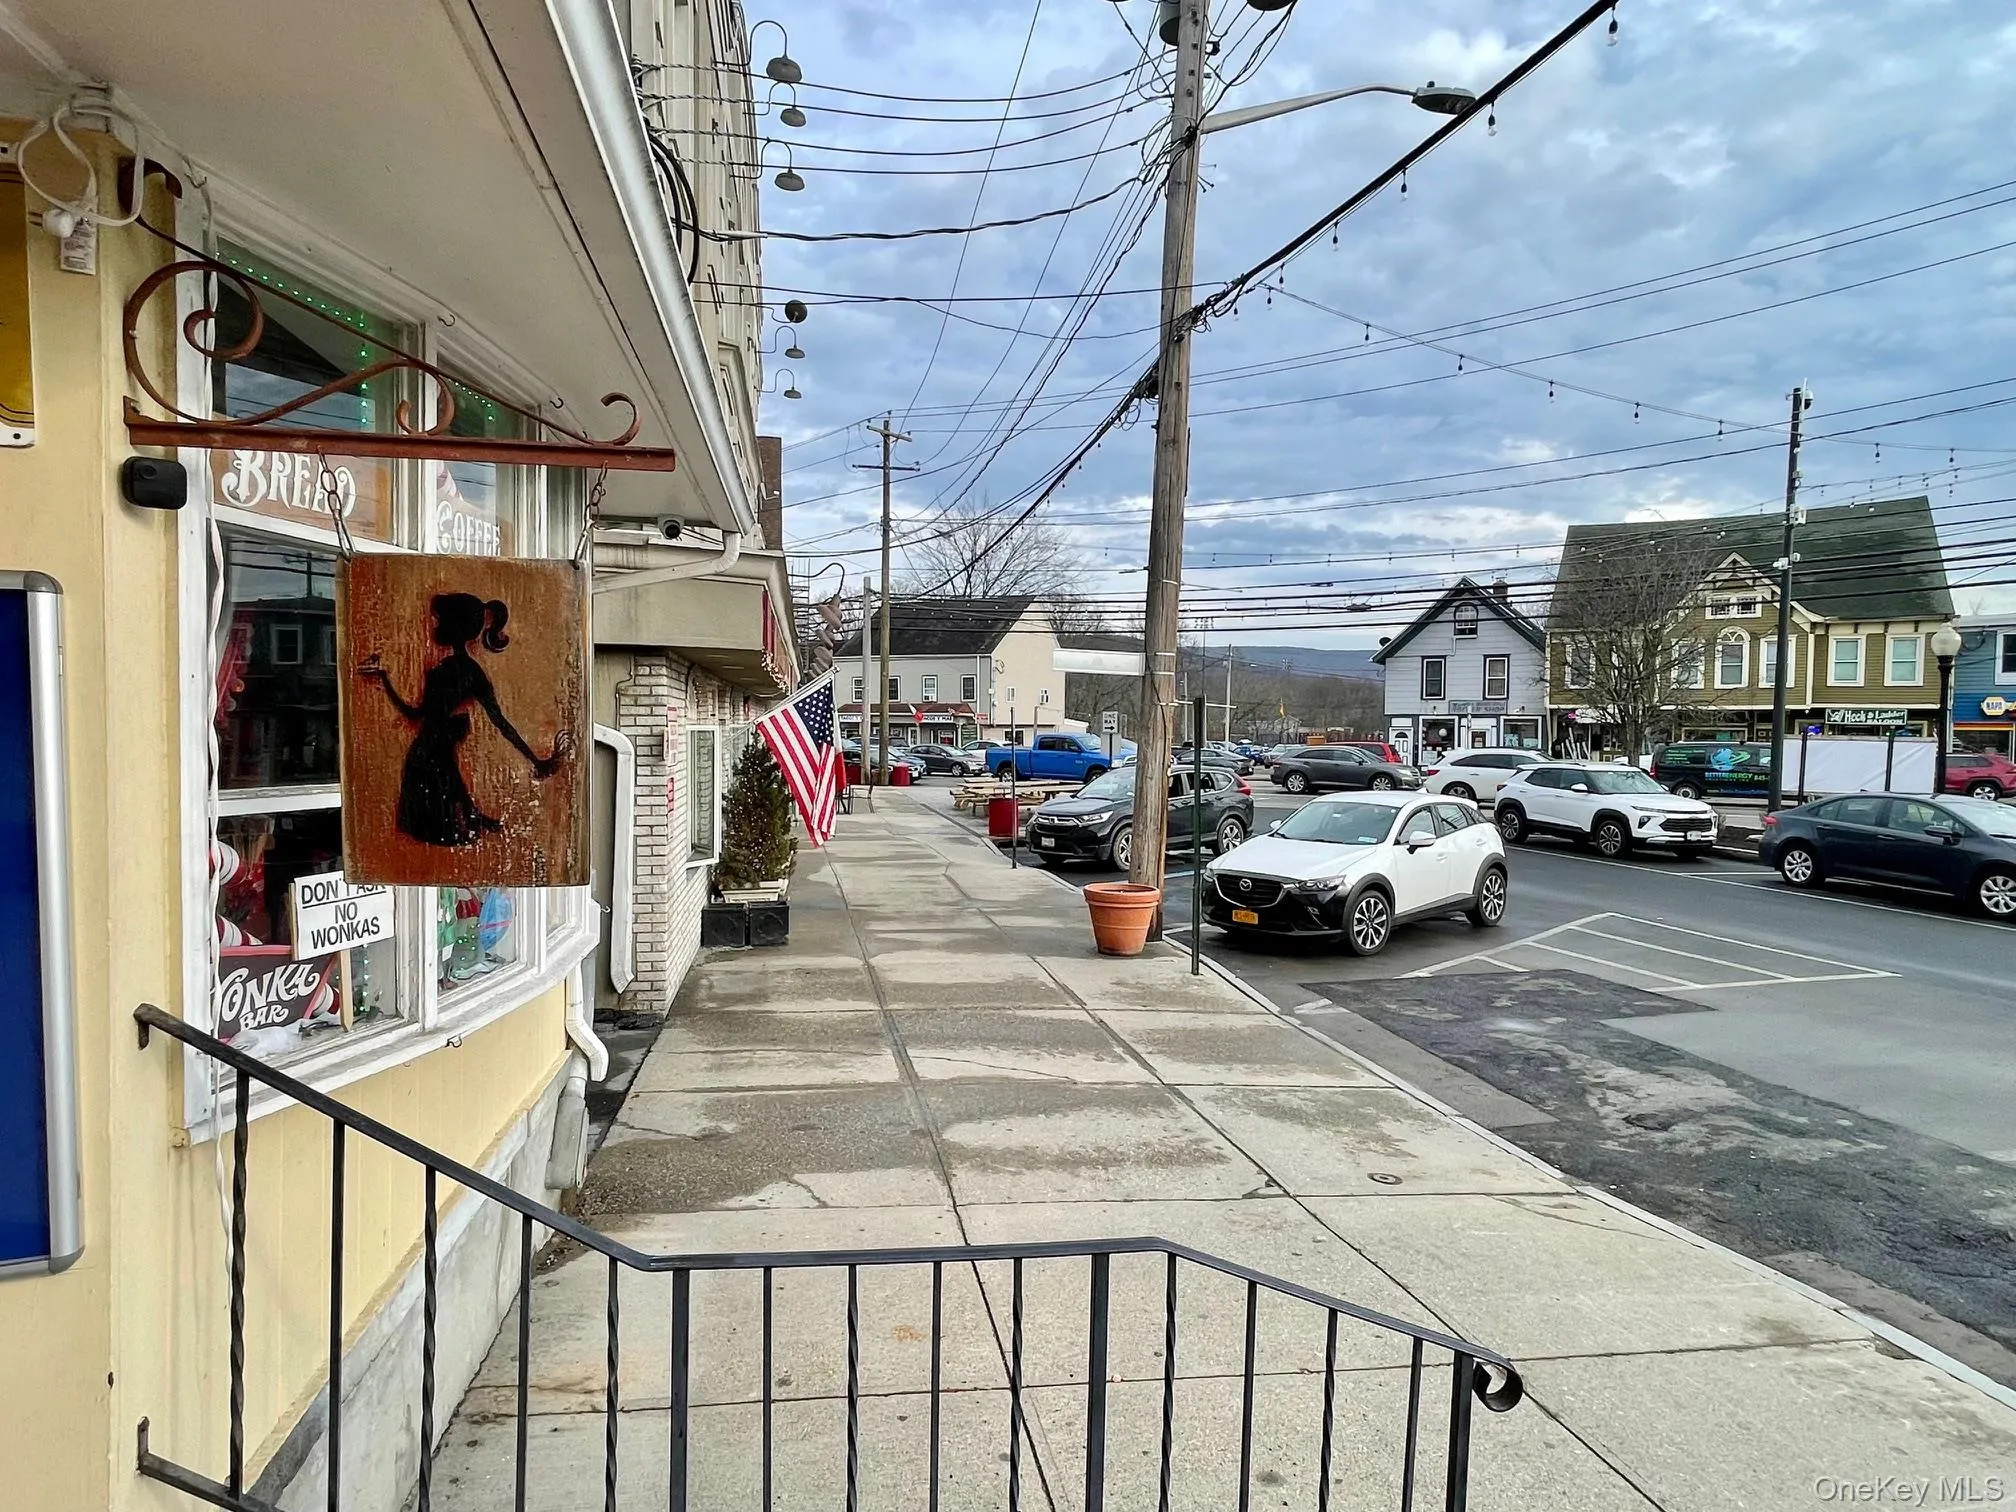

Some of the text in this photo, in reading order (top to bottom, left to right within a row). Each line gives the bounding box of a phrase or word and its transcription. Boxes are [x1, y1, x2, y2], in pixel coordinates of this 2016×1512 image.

[222, 449, 356, 518] BREAD
[437, 500, 500, 556] COFFEE
[335, 901, 358, 924] NO
[311, 916, 380, 950] WONKAS
[239, 1004, 289, 1032] BAR
